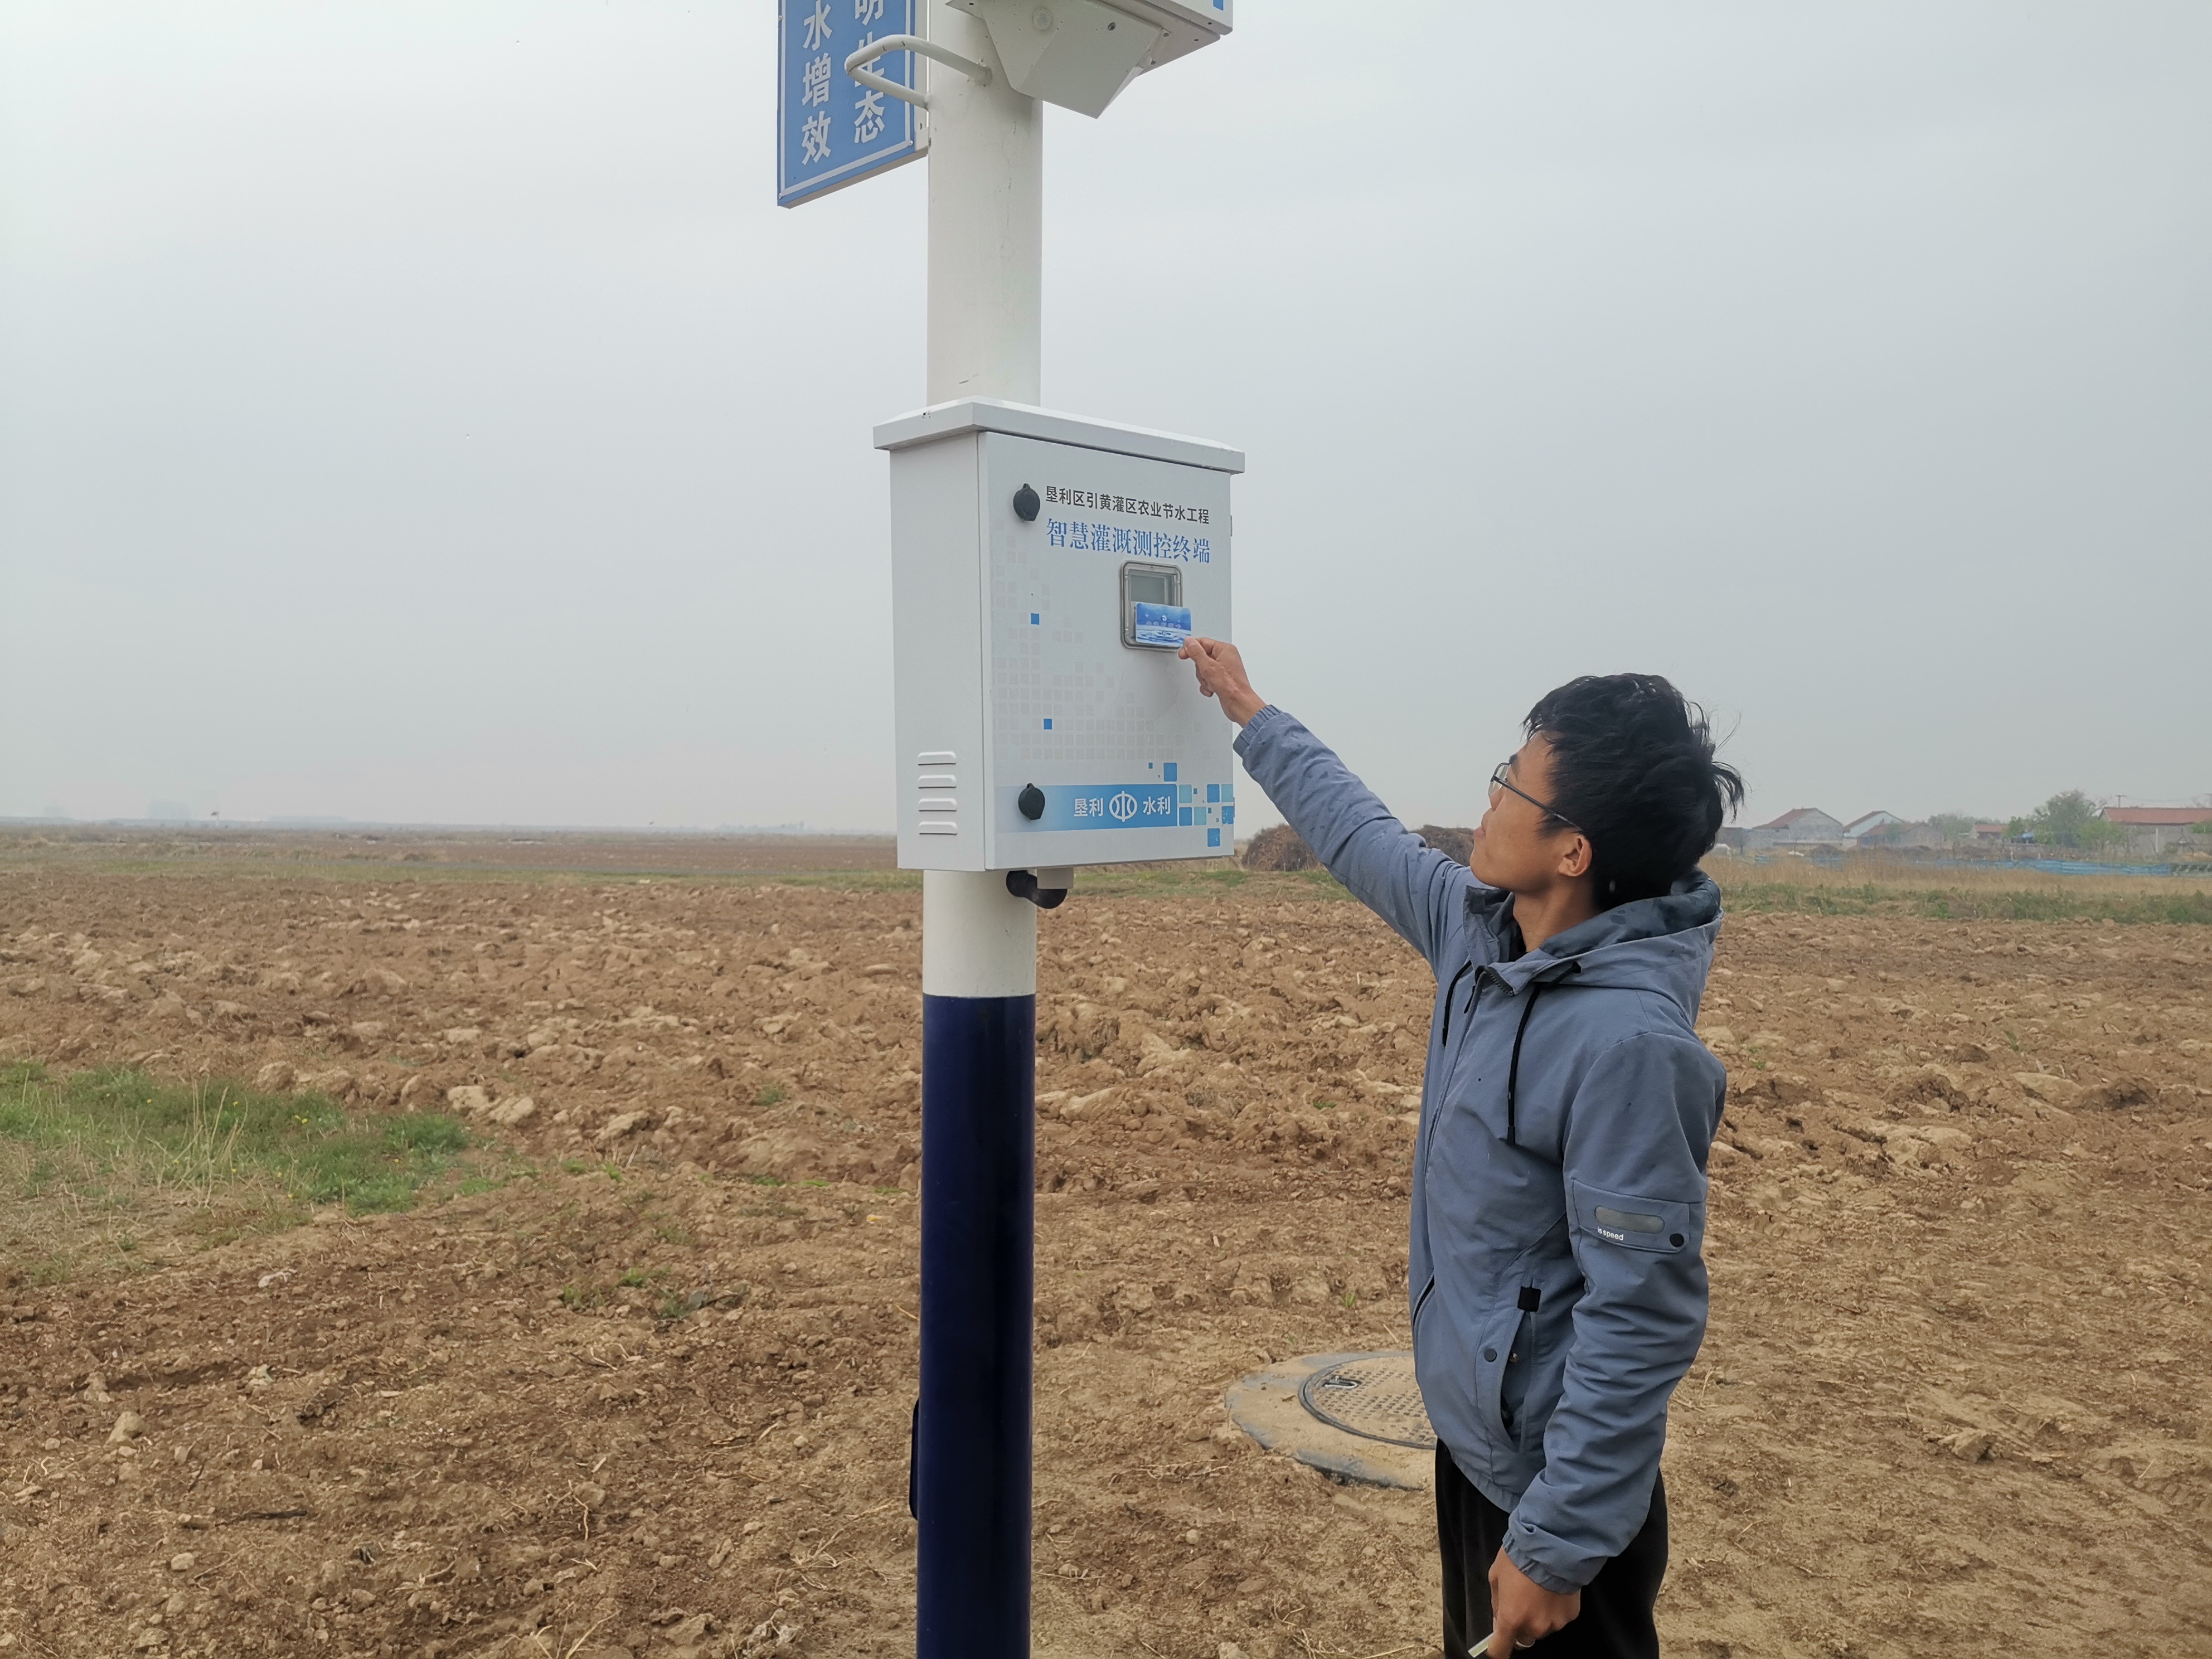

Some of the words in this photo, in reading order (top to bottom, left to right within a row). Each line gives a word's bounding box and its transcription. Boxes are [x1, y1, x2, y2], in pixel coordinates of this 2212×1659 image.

[802, 0, 832, 166] 水增效
[1046, 486, 1209, 524] 垦利区引黄灌区农业节水工程
[1046, 518, 1210, 564] 智慧灌溉测控终端
[1074, 798, 1103, 817] 垦利
[1142, 795, 1170, 815] 水利
